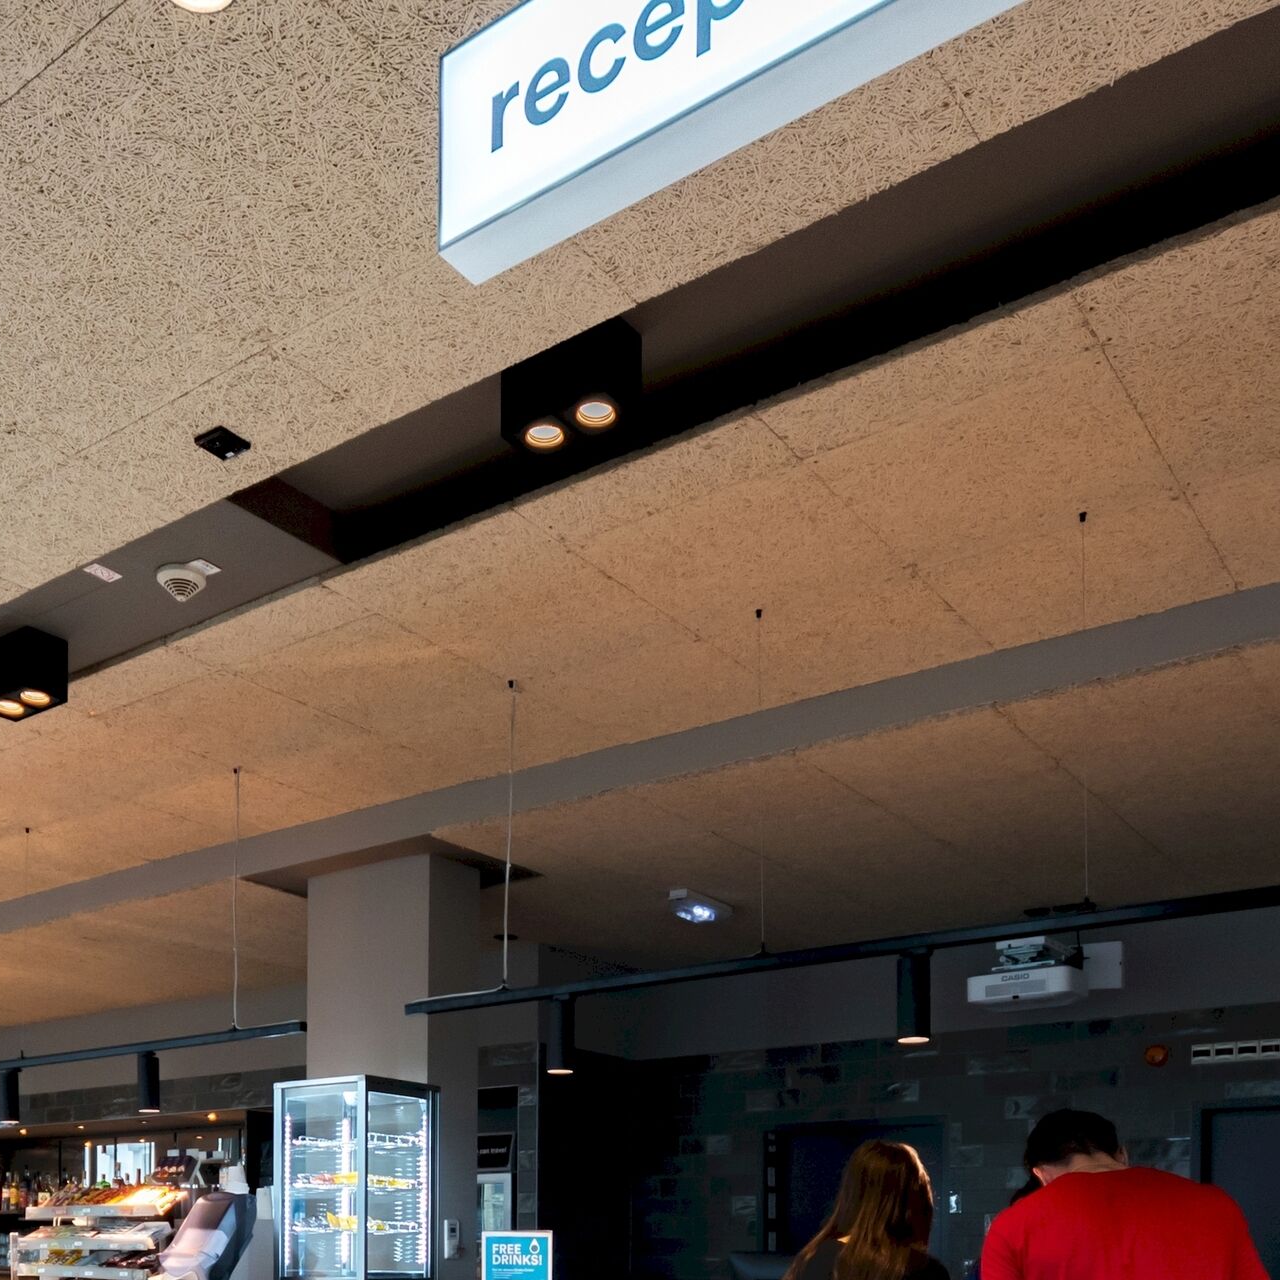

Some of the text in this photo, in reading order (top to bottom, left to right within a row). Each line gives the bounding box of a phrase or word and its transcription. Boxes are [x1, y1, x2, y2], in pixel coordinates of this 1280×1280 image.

[1001, 973, 1030, 982] CASIO
[492, 1244, 522, 1255] FREE
[492, 1254, 543, 1266] DRINKS!
